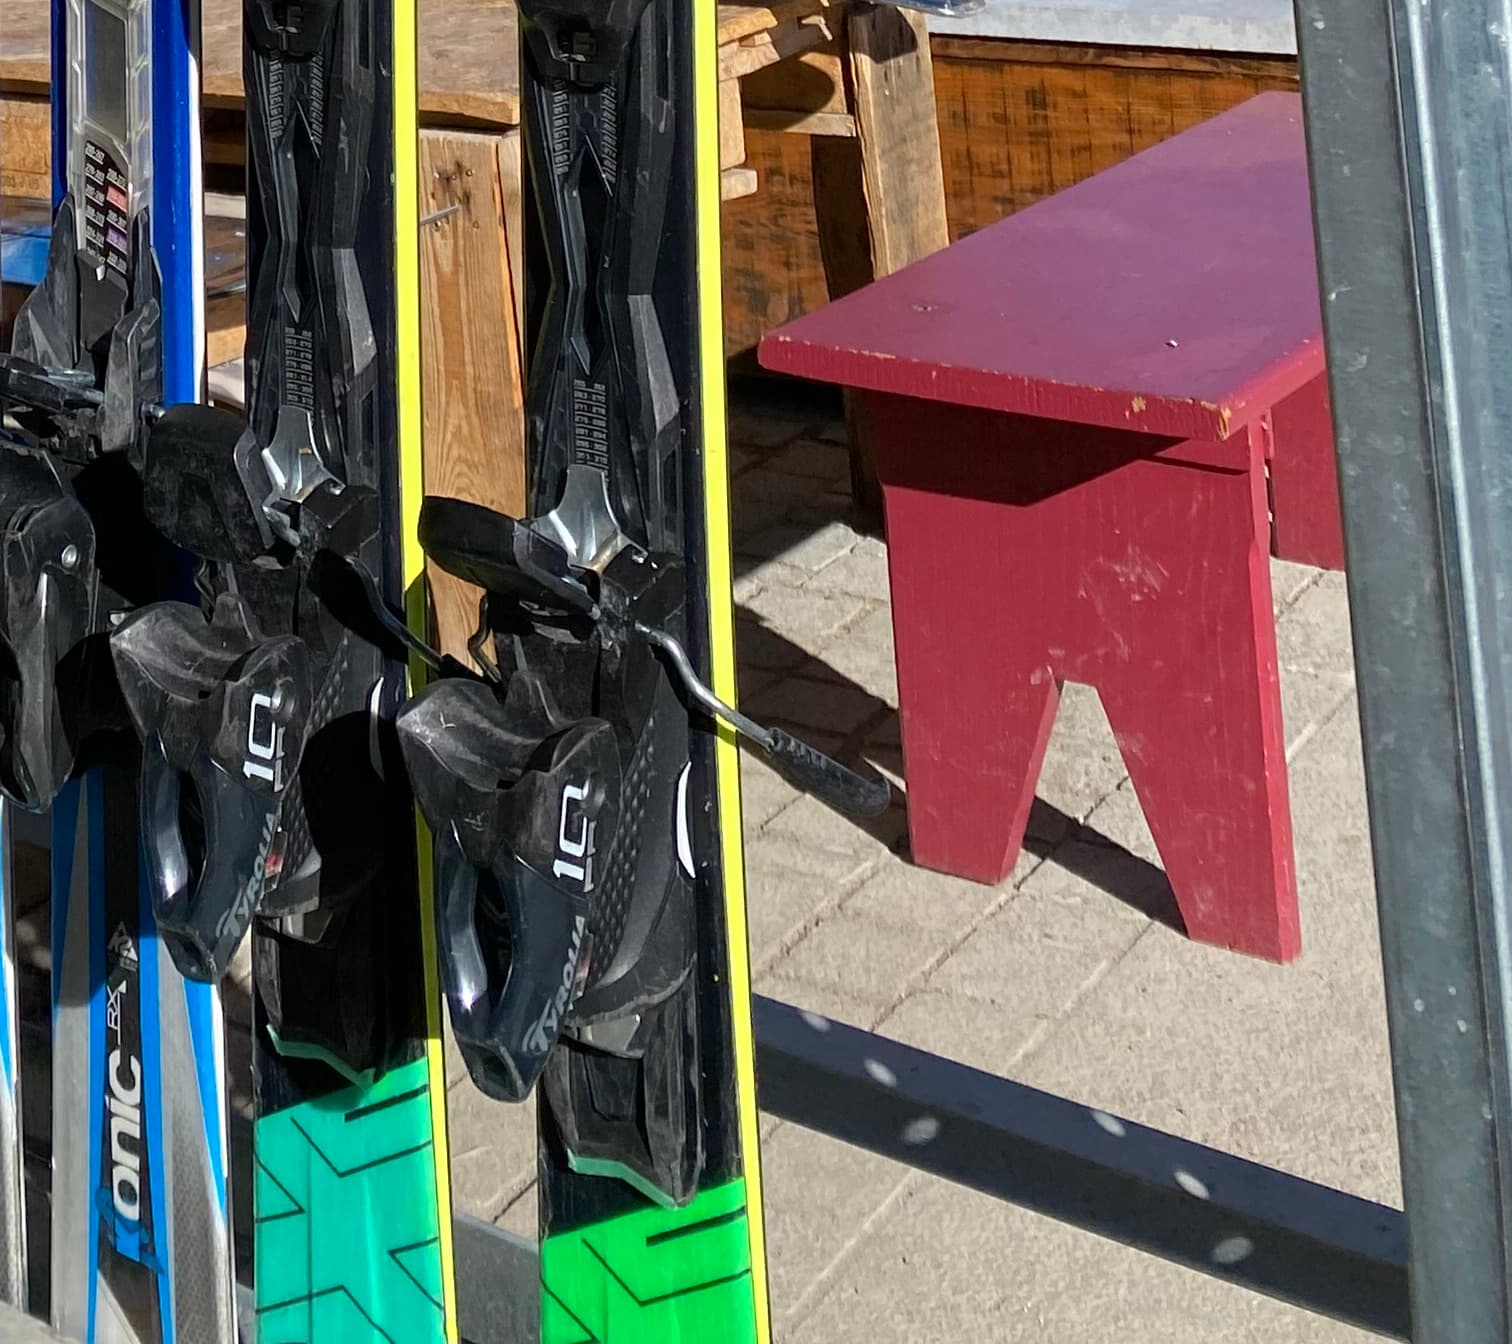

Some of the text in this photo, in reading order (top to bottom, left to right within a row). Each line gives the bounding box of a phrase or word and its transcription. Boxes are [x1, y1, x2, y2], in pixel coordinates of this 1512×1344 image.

[216, 812, 274, 938] TYROLIA
[107, 985, 120, 1034] RX
[521, 914, 585, 1052] TYROLIA
